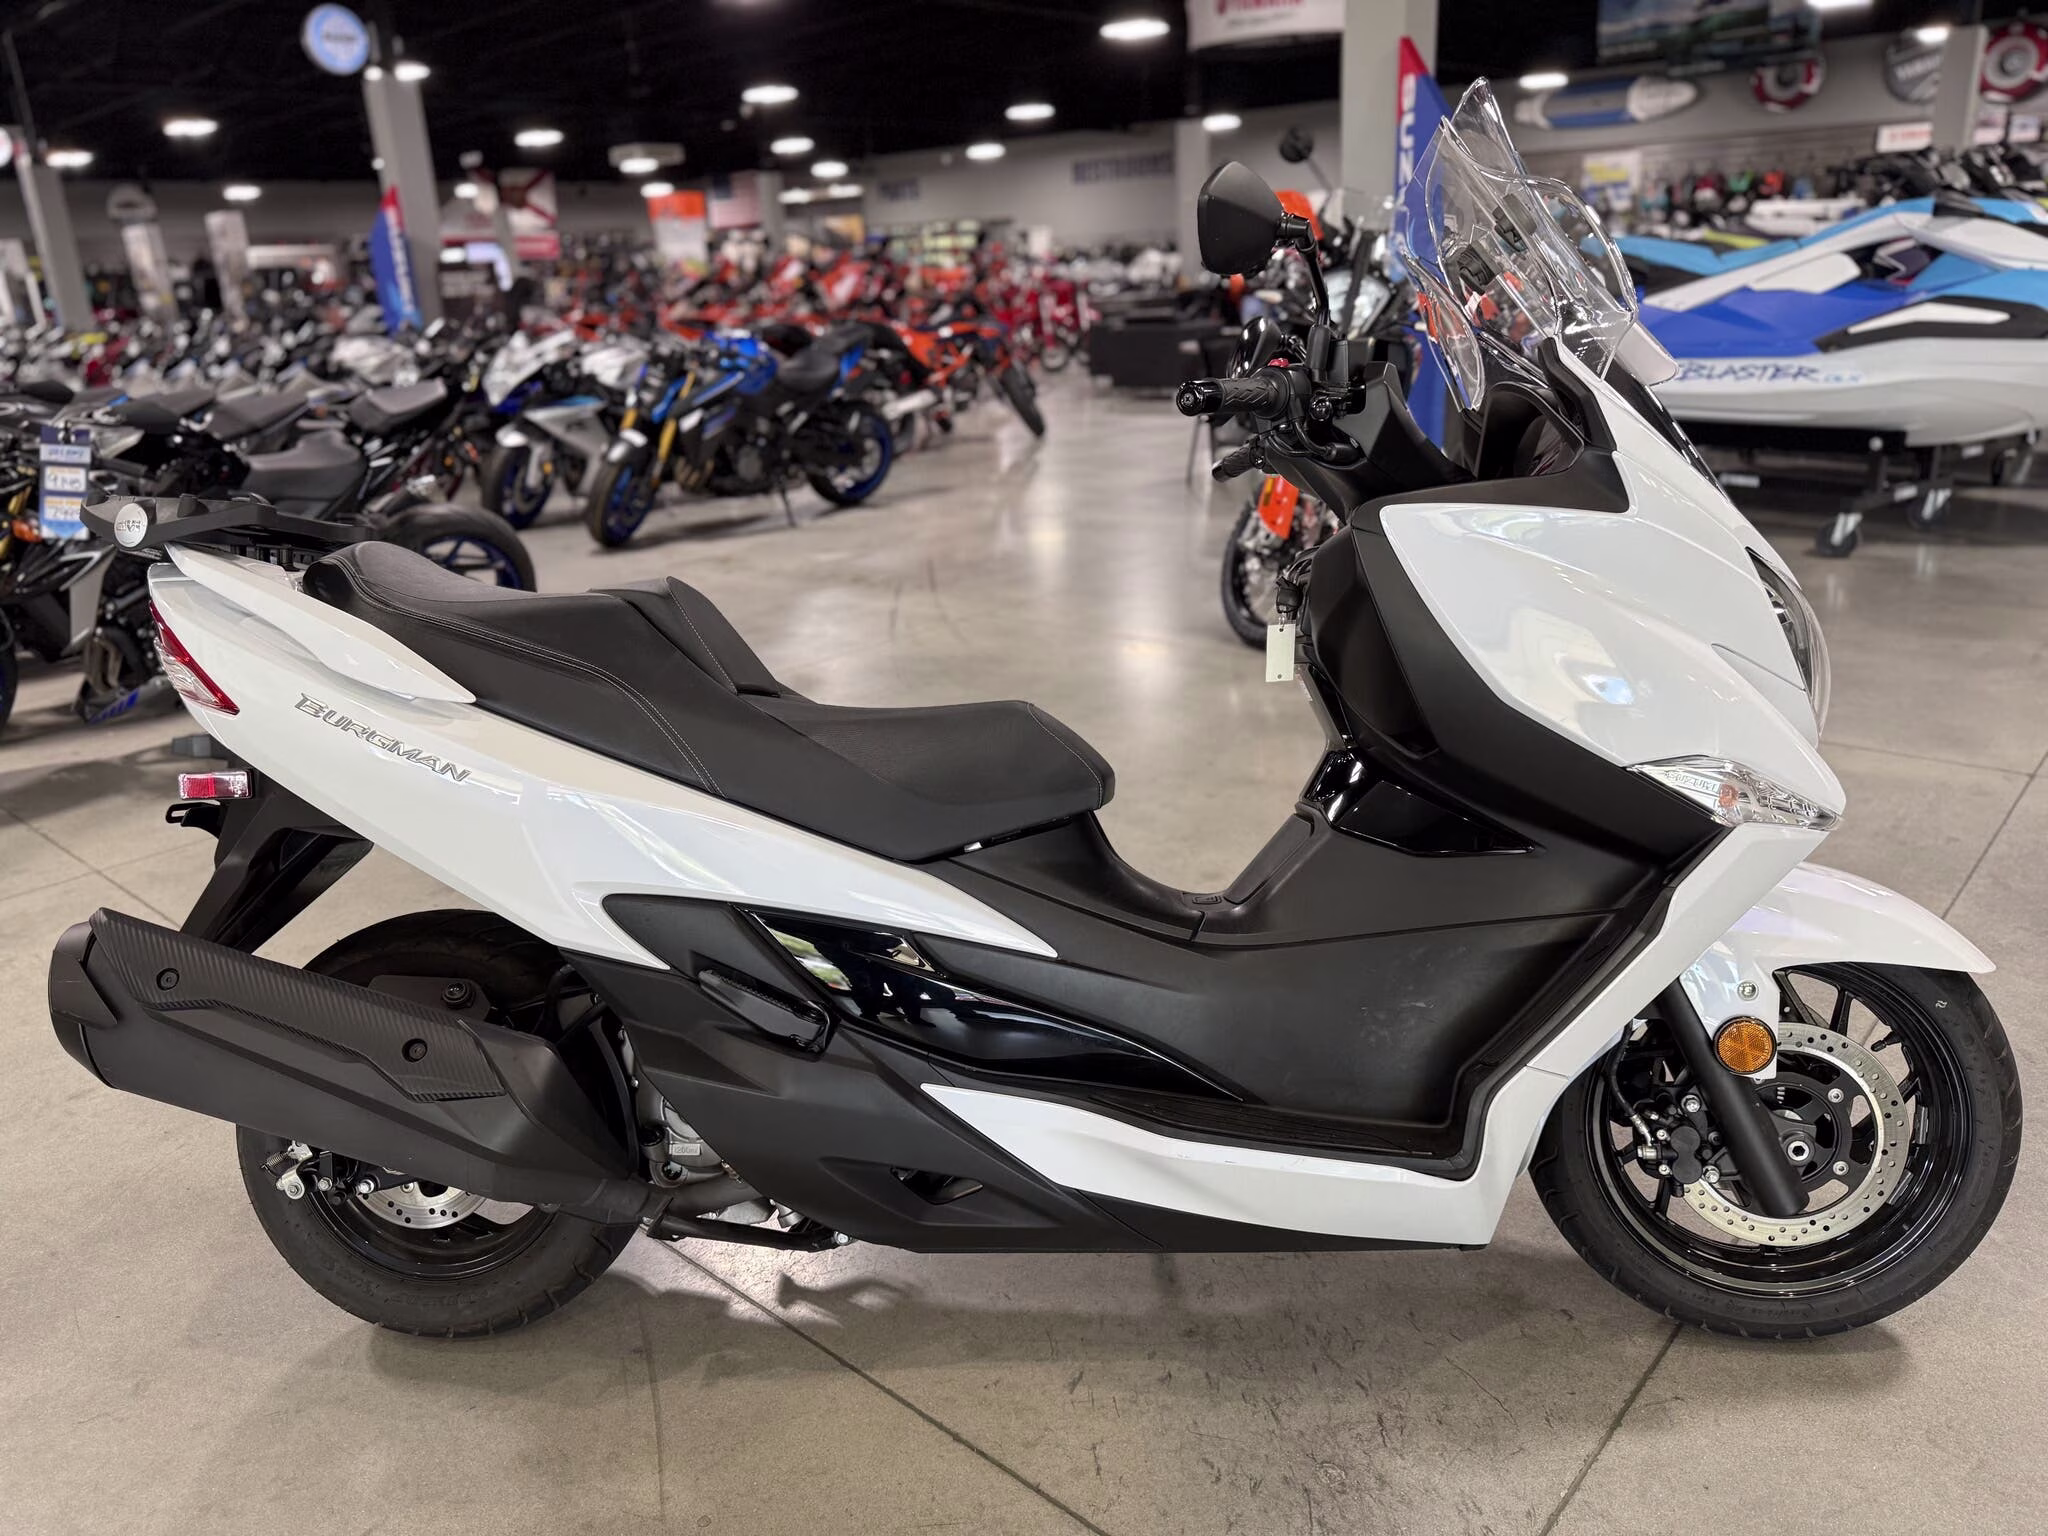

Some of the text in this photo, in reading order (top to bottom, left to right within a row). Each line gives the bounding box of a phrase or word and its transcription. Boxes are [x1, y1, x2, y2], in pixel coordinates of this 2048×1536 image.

[1674, 361, 1819, 383] BLASTER
[294, 692, 472, 782] BURGMAN
[1665, 770, 1720, 794] SUZUKI
